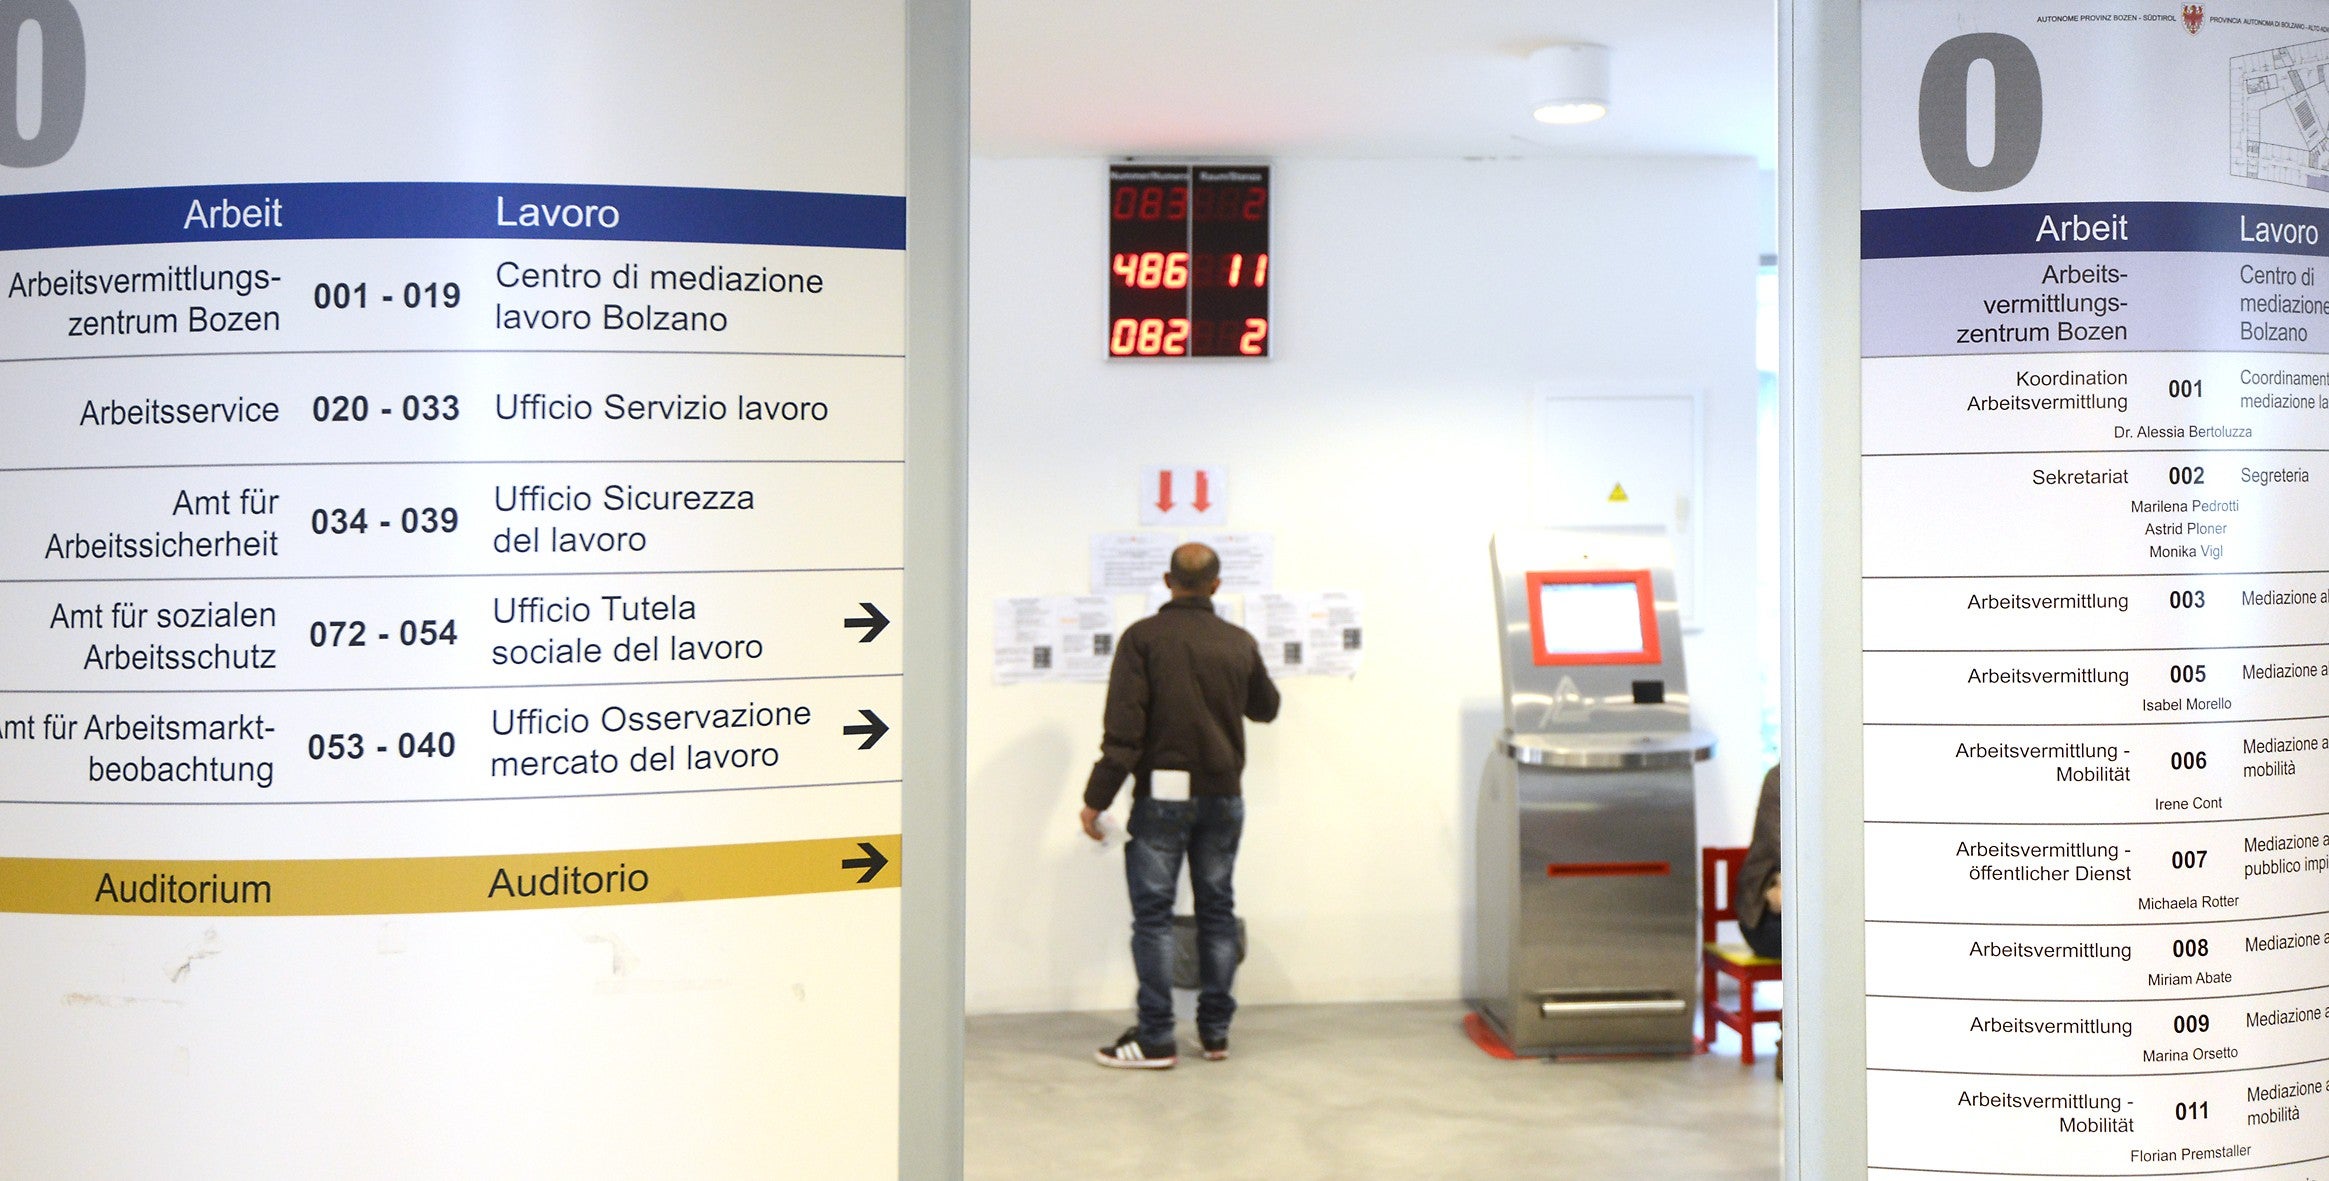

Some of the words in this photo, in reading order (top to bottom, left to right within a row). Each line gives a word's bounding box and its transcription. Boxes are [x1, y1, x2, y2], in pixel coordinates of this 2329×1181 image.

[2036, 15, 2079, 23] AUTONOME
[2079, 14, 2113, 22] PROVINZ
[2142, 13, 2177, 22] SÜDTIROL
[2209, 16, 2241, 24] PROVINCIA
[2243, 18, 2275, 27] AUTONOMA
[2275, 20, 2280, 28] DI
[2280, 21, 2305, 30] BOLZANO
[1918, 32, 2043, 192] 0
[183, 197, 283, 230] Arbeit
[497, 195, 620, 229] Lavoro
[1113, 186, 1189, 221] 083
[1243, 186, 1267, 221] 2
[2035, 213, 2129, 242] Arbeit
[2240, 214, 2319, 245] Lavoro
[496, 261, 602, 289] Centro
[612, 263, 638, 289] di
[651, 265, 824, 294] mediazione
[1113, 252, 1190, 289] 486
[1228, 253, 1268, 287] 11
[2041, 263, 2128, 285] Arbeits-
[2240, 264, 2297, 286] Centro
[2301, 267, 2314, 287] di
[8, 264, 281, 299] Arbeitsvermittlungs-
[314, 282, 366, 310] 001
[379, 294, 395, 302] -
[403, 281, 461, 309] 019
[1983, 293, 2128, 317] vermittlungs-
[68, 310, 177, 337] zentrum
[189, 306, 280, 333] Bozen
[496, 303, 591, 330] lavoro
[604, 304, 728, 332] Bolzano
[1110, 318, 1191, 355] 082
[1239, 318, 1268, 355] 2
[1956, 323, 2050, 344] zentrum
[2058, 321, 2127, 341] Bozen
[2240, 321, 2308, 342] Bolzano
[2016, 369, 2128, 387] Koordination
[2168, 379, 2202, 398] 001
[79, 396, 279, 426] Arbeitsservice
[312, 395, 369, 423] 020
[379, 407, 394, 416] -
[402, 394, 460, 422] 033
[496, 393, 592, 420] Ufficio
[604, 393, 727, 421] Servizio
[738, 394, 828, 421] lavoro
[1966, 393, 2128, 413] Arbeitsvermittlung
[2240, 393, 2316, 409] mediazione
[2114, 425, 2133, 439] Dr.
[2136, 425, 2185, 438] Alessia
[2189, 425, 2252, 438] Bertoluzza
[2032, 468, 2129, 485] Sekretariat
[2169, 466, 2205, 485] 002
[2241, 467, 2309, 487] Segreteria
[172, 489, 231, 516] Amt
[239, 488, 280, 515] für
[495, 485, 592, 512] Ufficio
[603, 484, 754, 511] Sicurezza
[2131, 500, 2188, 513] Marilena
[2192, 499, 2239, 512] Pedrotti
[311, 507, 368, 535] 034
[379, 518, 393, 527] -
[401, 506, 458, 534] 039
[2144, 522, 2183, 536] Astrid
[2187, 522, 2227, 535] Ploner
[44, 530, 279, 559] Arbeitssicherheit
[493, 526, 539, 554] del
[552, 526, 647, 553] lavoro
[2149, 545, 2197, 558] Monika
[2200, 544, 2223, 560] Vigl
[1967, 593, 2129, 612] Arbeitsvermittlung
[2169, 590, 2205, 609] 003
[2242, 589, 2317, 606] Mediazione
[49, 602, 103, 629] Amt
[111, 602, 149, 629] für
[157, 601, 276, 629] sozialen
[494, 596, 590, 624] Ufficio
[601, 594, 696, 622] Tutela
[310, 620, 366, 648] 072
[377, 632, 392, 641] -
[399, 619, 458, 646] 054
[83, 643, 276, 670] Arbeitsschutz
[492, 637, 602, 665] sociale
[613, 635, 658, 663] del
[671, 635, 763, 661] lavoro
[1967, 667, 2129, 687] Arbeitsvermittlung
[2170, 664, 2206, 684] 005
[2242, 662, 2318, 680] Mediazione
[2143, 698, 2182, 712] Isabel
[2186, 697, 2232, 711] Morello
[0, 715, 35, 740] mt
[42, 713, 78, 740] für
[83, 713, 275, 741] Arbeitsmarkt-
[492, 707, 589, 736] Ufficio
[601, 701, 811, 733] Osservazione
[308, 733, 365, 761] 053
[376, 745, 389, 754] -
[398, 731, 456, 759] 040
[1955, 742, 2118, 762] Arbeitsvermittlung
[2243, 736, 2319, 754] Mediazione
[491, 749, 618, 777] mercato
[630, 745, 674, 773] del
[687, 744, 779, 770] lavoro
[2170, 751, 2207, 771] 006
[2243, 759, 2296, 778] mobilità
[89, 755, 273, 789] beobachtung
[2057, 766, 2131, 782] Mobilität
[2155, 798, 2189, 811] Irene
[2192, 796, 2223, 810] Cont
[1955, 841, 2119, 862] Arbeitsvermittlung
[2244, 834, 2320, 853] Mediazione
[2171, 850, 2208, 870] 007
[2244, 858, 2301, 880] pubblico
[487, 863, 649, 899] Auditorio
[1969, 864, 2070, 881] öffentlicher
[2075, 865, 2132, 881] Dienst
[94, 872, 271, 904] Auditorium
[2138, 896, 2198, 910] Michaela
[2202, 895, 2240, 908] Rotter
[1969, 941, 2132, 962] Arbeitsvermittlung
[2172, 938, 2209, 958] 008
[2245, 932, 2321, 953] Mediazione
[2148, 973, 2193, 986] Miriam
[2195, 971, 2232, 985] Abate
[1969, 1016, 2132, 1038] Arbeitsvermittlung
[2173, 1014, 2210, 1034] 009
[2246, 1007, 2322, 1028] Mediazione
[2143, 1049, 2189, 1063] Marina
[2192, 1046, 2239, 1061] Orsetto
[1957, 1090, 2121, 1113] Arbeitsvermittlung
[2247, 1081, 2323, 1103] Mediazione
[2175, 1100, 2208, 1121] 011
[2247, 1105, 2300, 1126] mobilità
[2060, 1117, 2135, 1133] Mobilität
[2130, 1149, 2177, 1163] Florian
[2181, 1144, 2252, 1161] Premstaller
